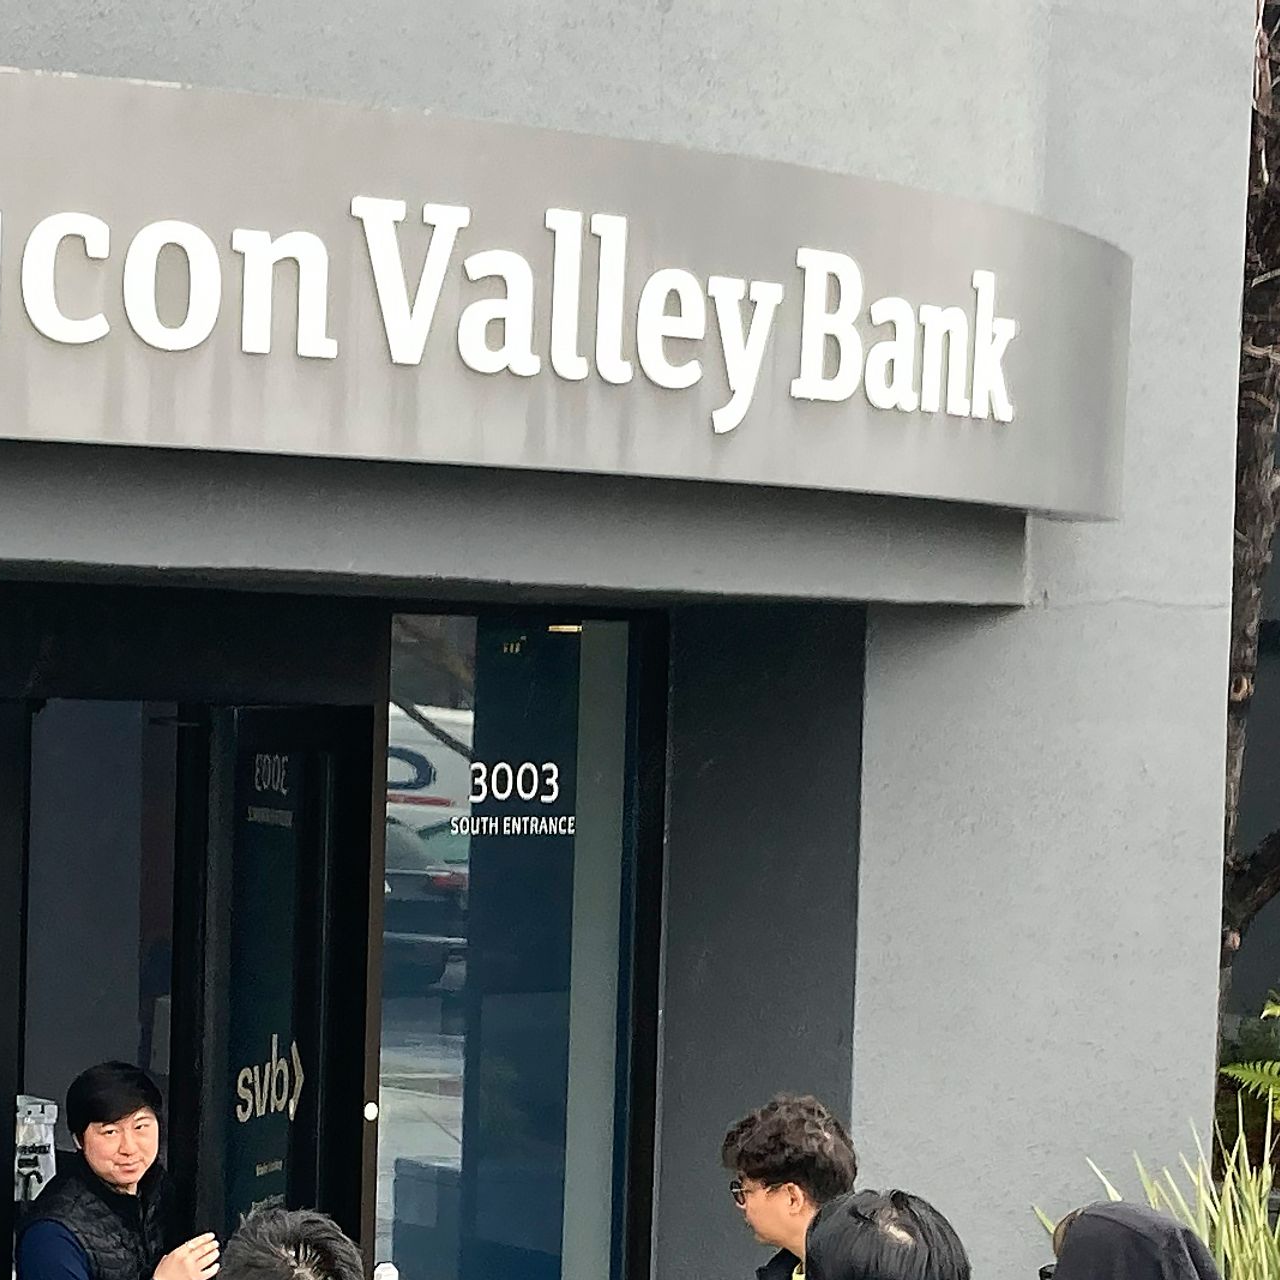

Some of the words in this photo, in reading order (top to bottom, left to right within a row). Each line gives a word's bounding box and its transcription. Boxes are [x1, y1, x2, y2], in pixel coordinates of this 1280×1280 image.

[350, 195, 784, 434] Valley
[789, 246, 1017, 422] Bank
[468, 761, 559, 804] 3003
[450, 815, 499, 836] SOUTH
[503, 815, 576, 835] ENTRANCE
[236, 1033, 289, 1123] svb
